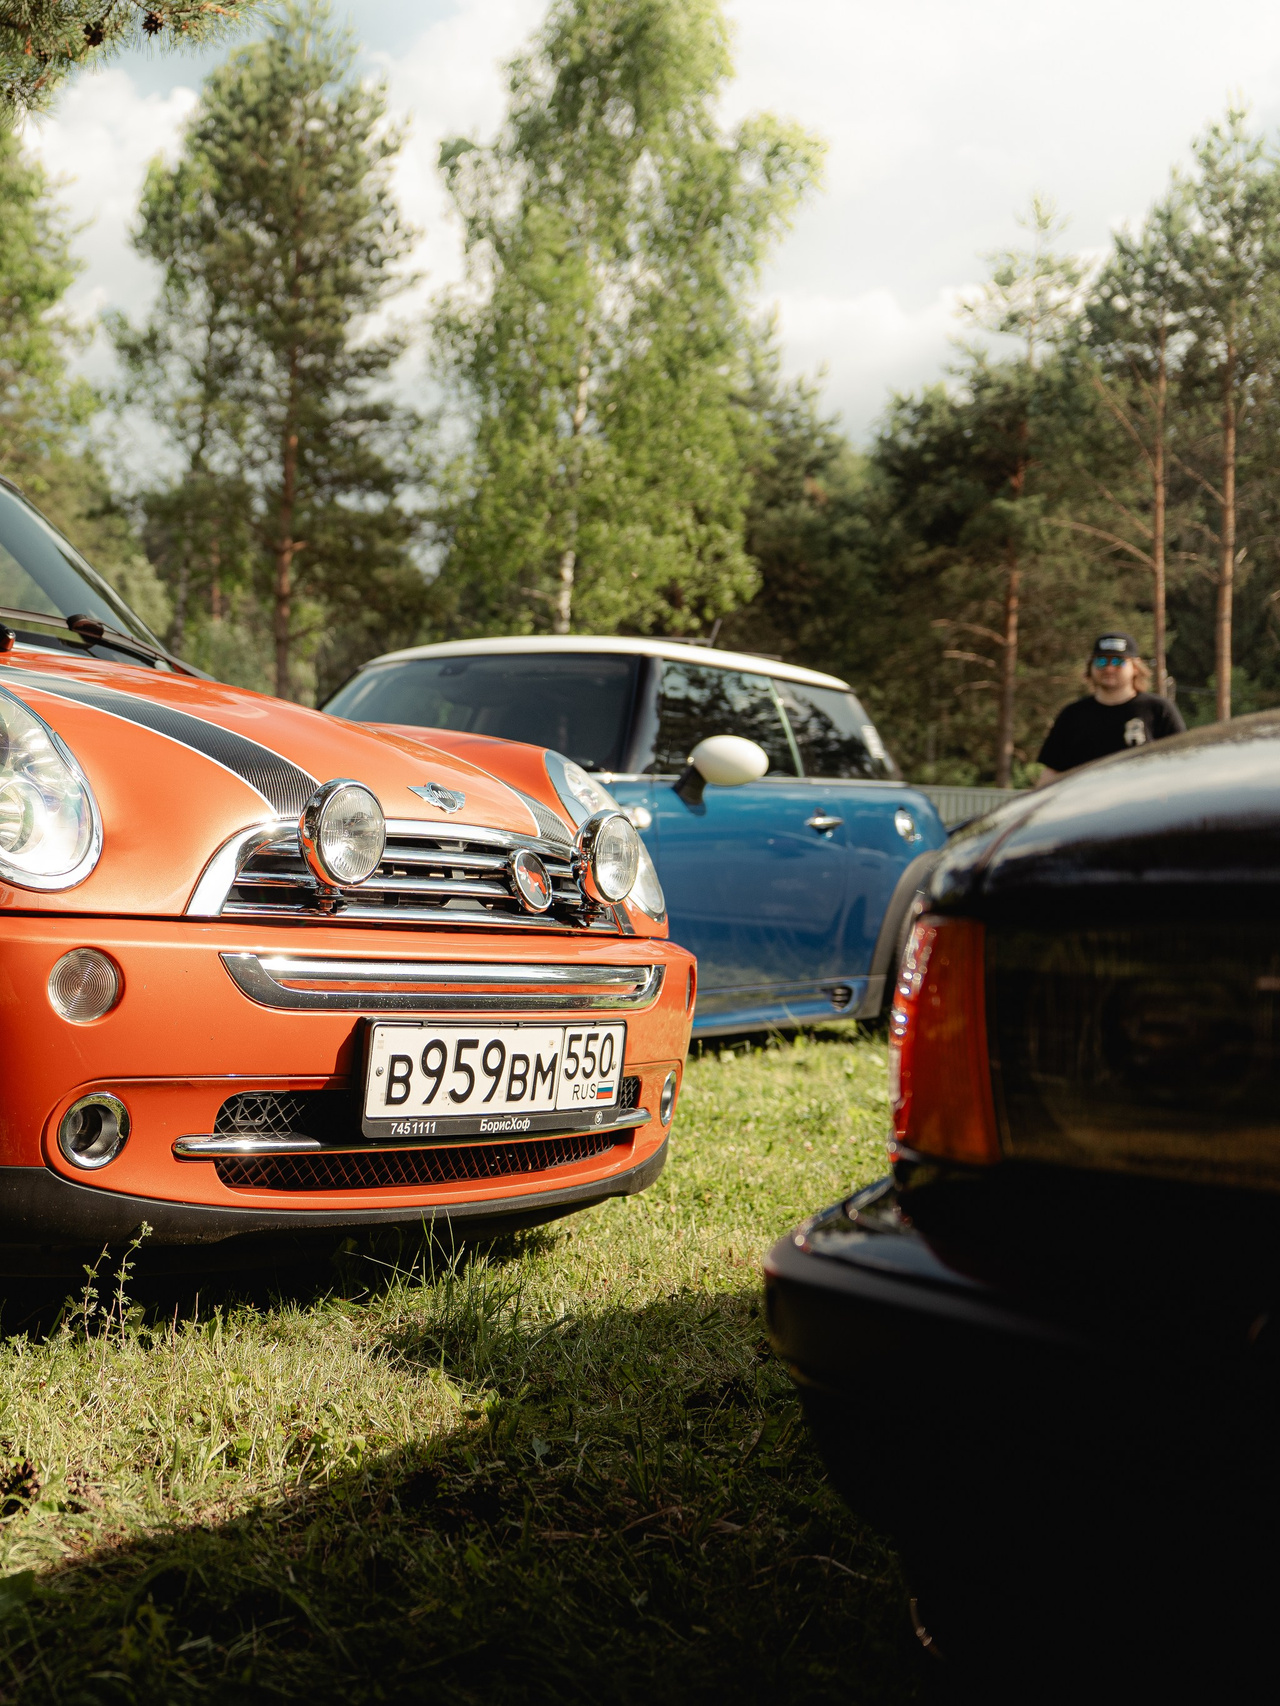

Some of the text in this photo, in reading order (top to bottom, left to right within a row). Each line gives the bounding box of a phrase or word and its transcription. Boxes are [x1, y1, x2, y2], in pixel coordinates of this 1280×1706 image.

[431, 790, 455, 800] MINI
[563, 1032, 614, 1080] 550
[571, 1083, 596, 1101] RUS
[390, 1121, 437, 1135] 7451111
[479, 1117, 531, 1132] БорисХоф
